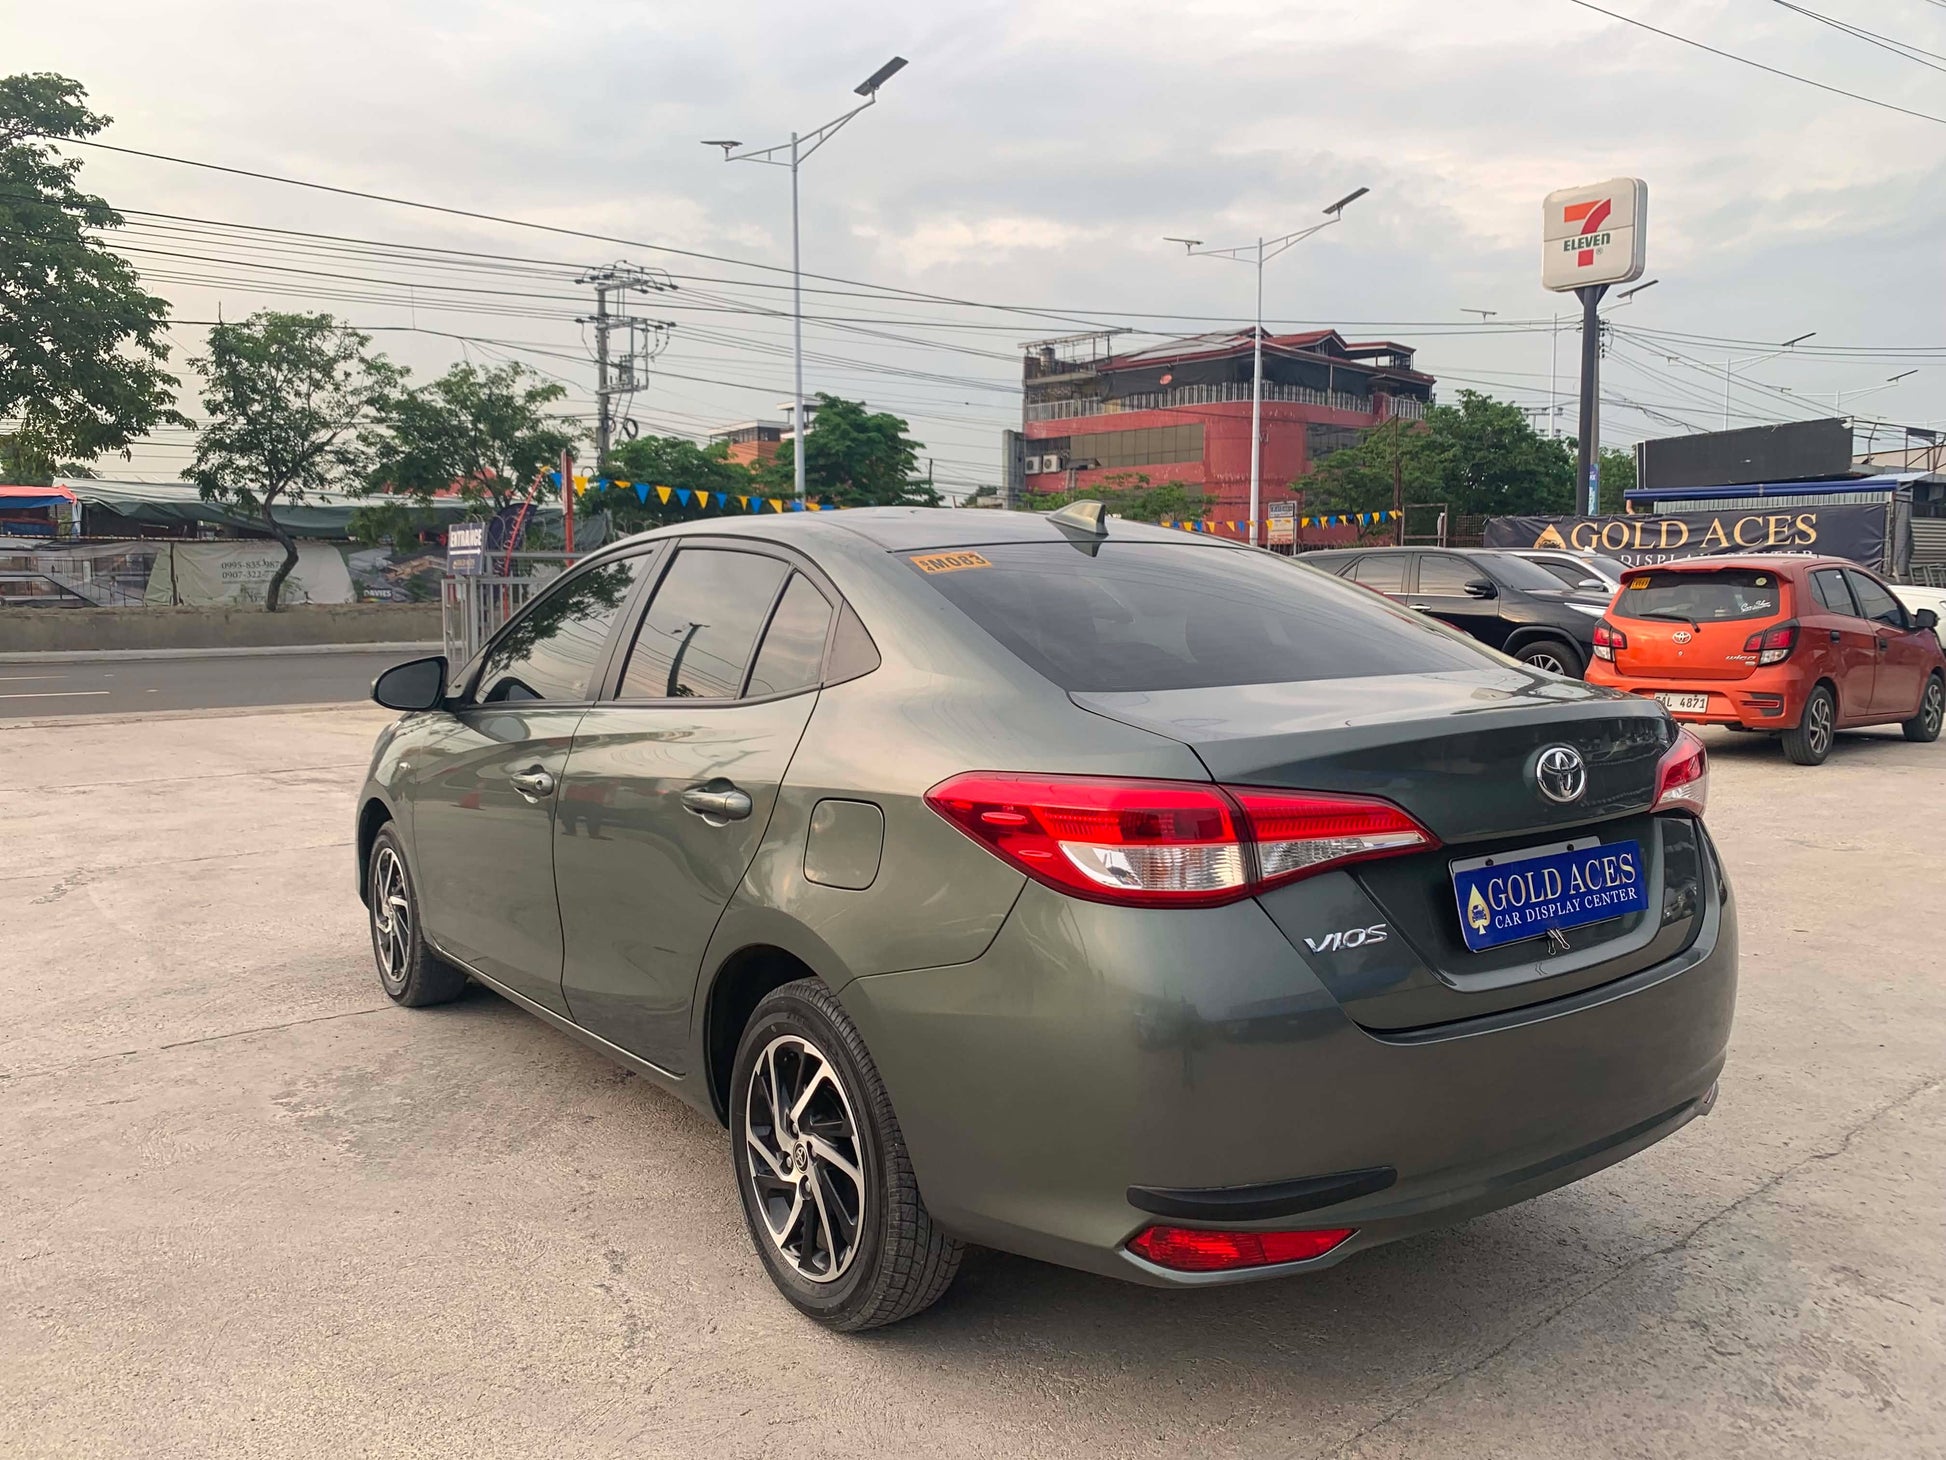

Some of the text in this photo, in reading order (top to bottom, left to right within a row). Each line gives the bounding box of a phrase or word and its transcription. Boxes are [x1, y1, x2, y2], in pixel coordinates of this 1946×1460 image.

[1564, 197, 1612, 268] 7
[1571, 513, 1817, 550] GOLD ACES
[363, 589, 392, 598] DAVIES
[1679, 697, 1706, 709] 4871
[1487, 853, 1636, 911] GOLD ACES
[1494, 887, 1638, 929] CAR DISPLAY CENTER
[1303, 923, 1388, 953] VIOS
